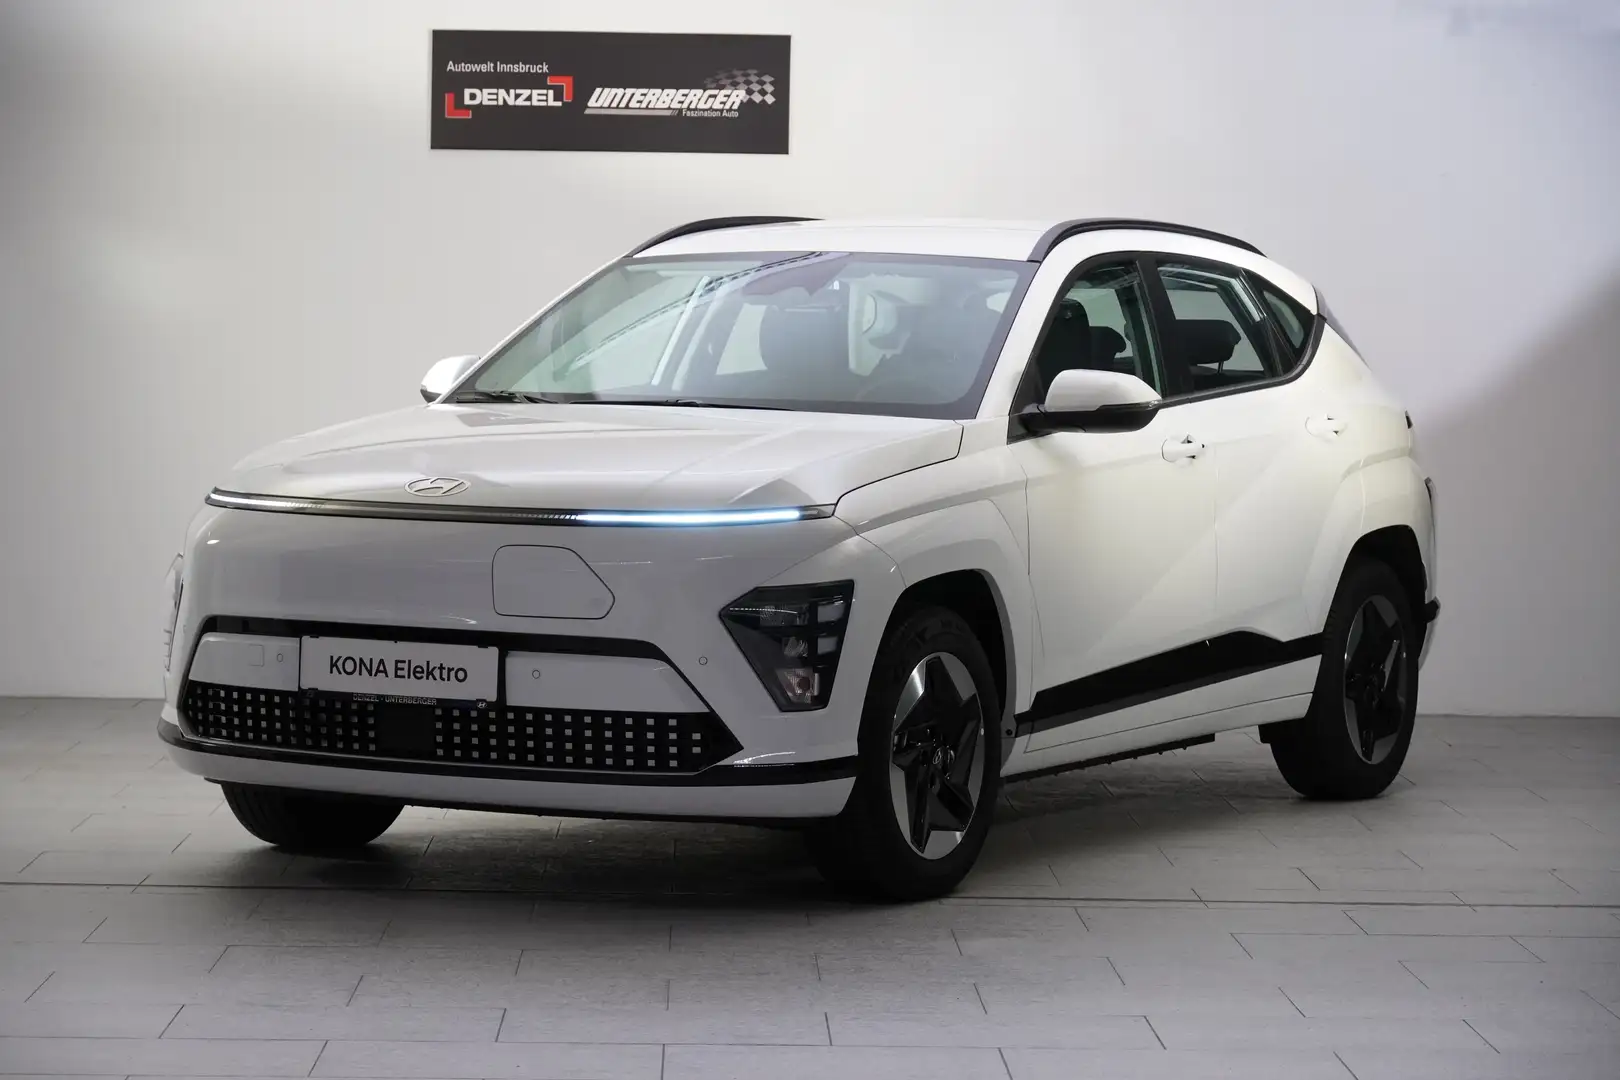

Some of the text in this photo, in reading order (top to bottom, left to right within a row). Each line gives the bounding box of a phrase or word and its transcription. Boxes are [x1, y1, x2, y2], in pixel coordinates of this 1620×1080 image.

[446, 60, 549, 74] Autowelt Innsbruck
[463, 88, 563, 107] DENZEL
[587, 87, 747, 110] UNTERBERGER
[682, 108, 739, 118] Faszination Auto
[329, 655, 468, 683] KONA Elektro
[352, 693, 437, 706] DENZEL UNTERBERGER
